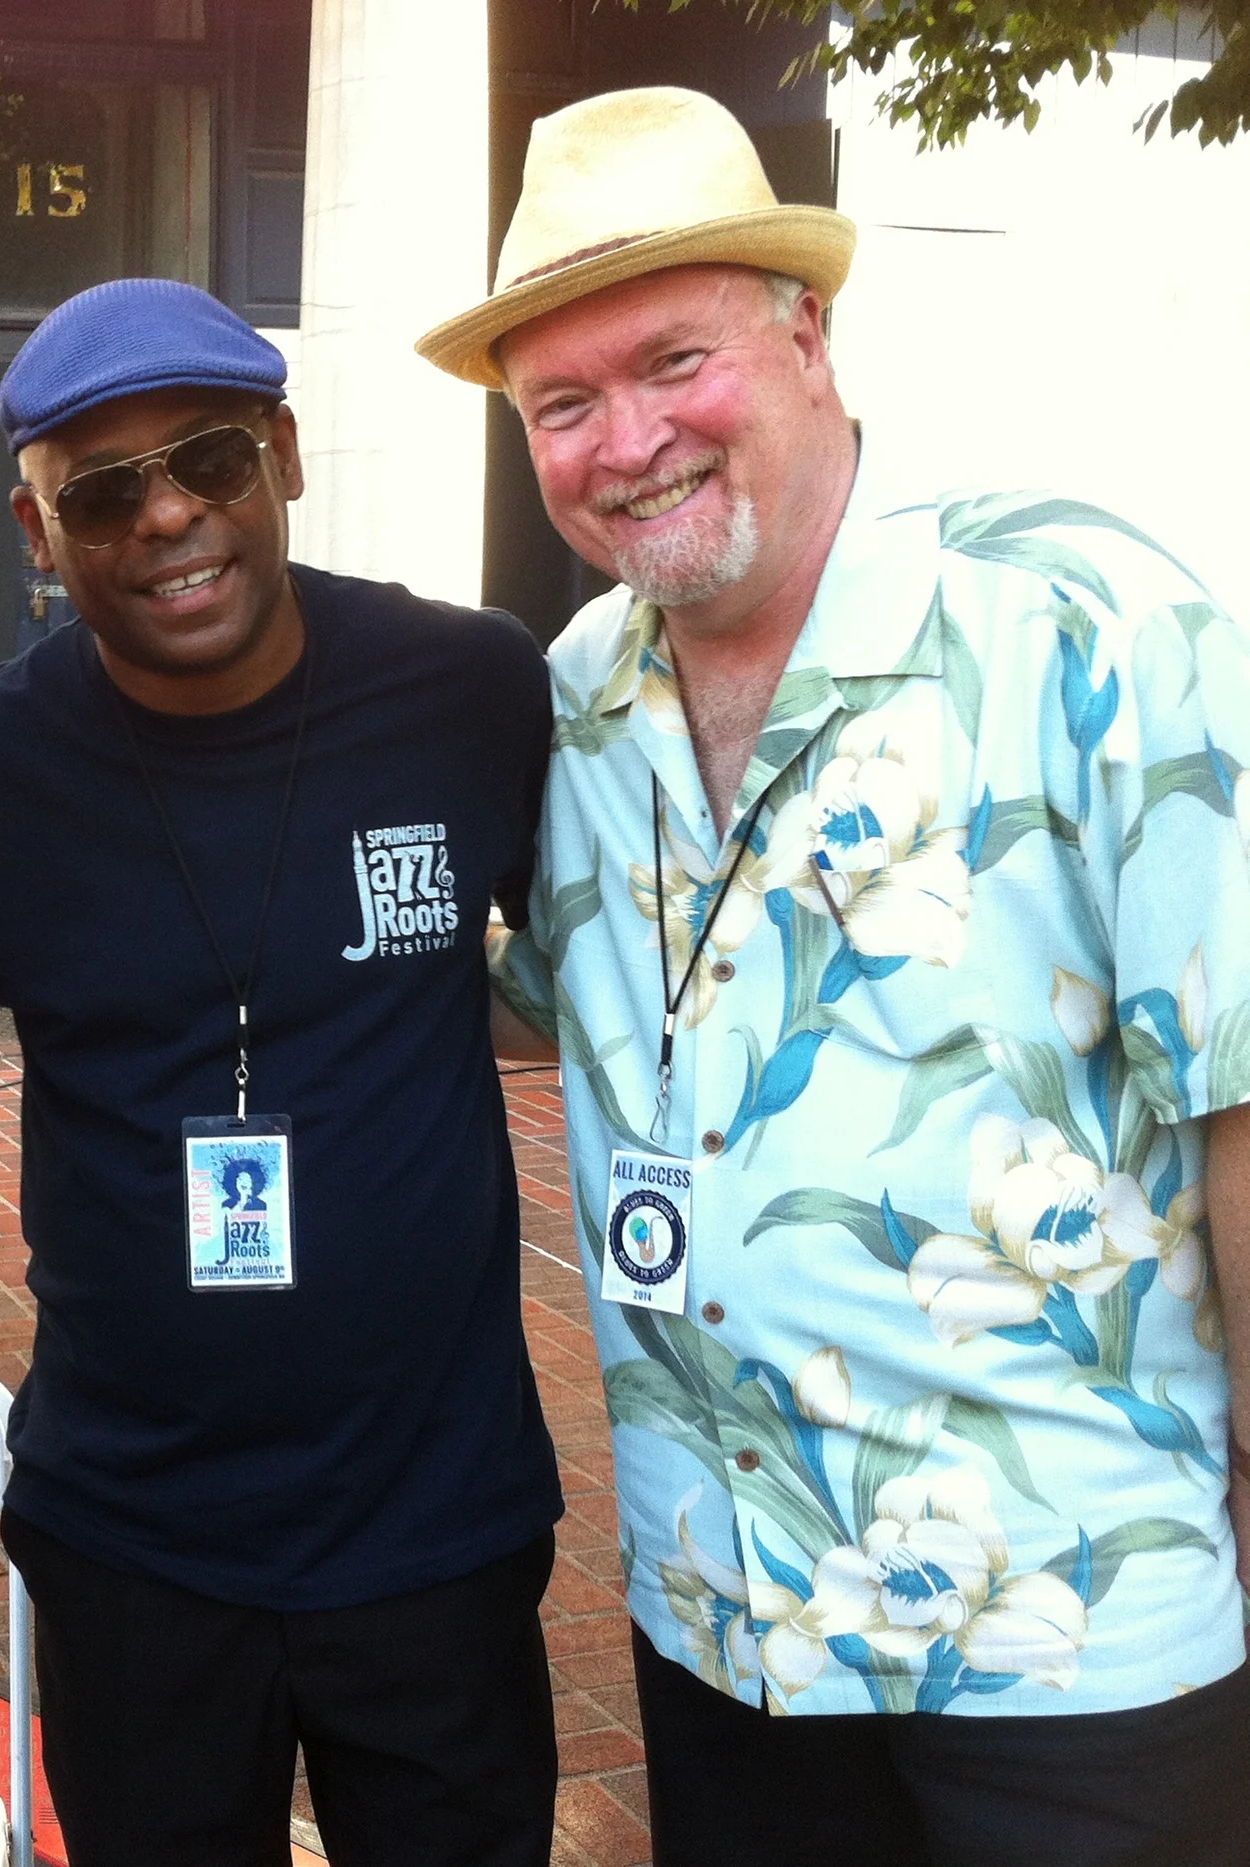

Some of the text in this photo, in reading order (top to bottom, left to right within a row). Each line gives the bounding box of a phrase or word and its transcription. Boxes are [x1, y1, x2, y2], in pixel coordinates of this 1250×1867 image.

[15, 163, 87, 217] 15
[365, 823, 446, 848] SPRINGFIELD
[373, 893, 459, 938] Roots
[378, 932, 456, 957] Festival
[613, 1160, 691, 1189] ALL ACCESS
[191, 1168, 212, 1237] ARTIST
[231, 1240, 270, 1258] Roots
[194, 1265, 233, 1275] SATURDAY
[242, 1265, 273, 1274] AUGUST
